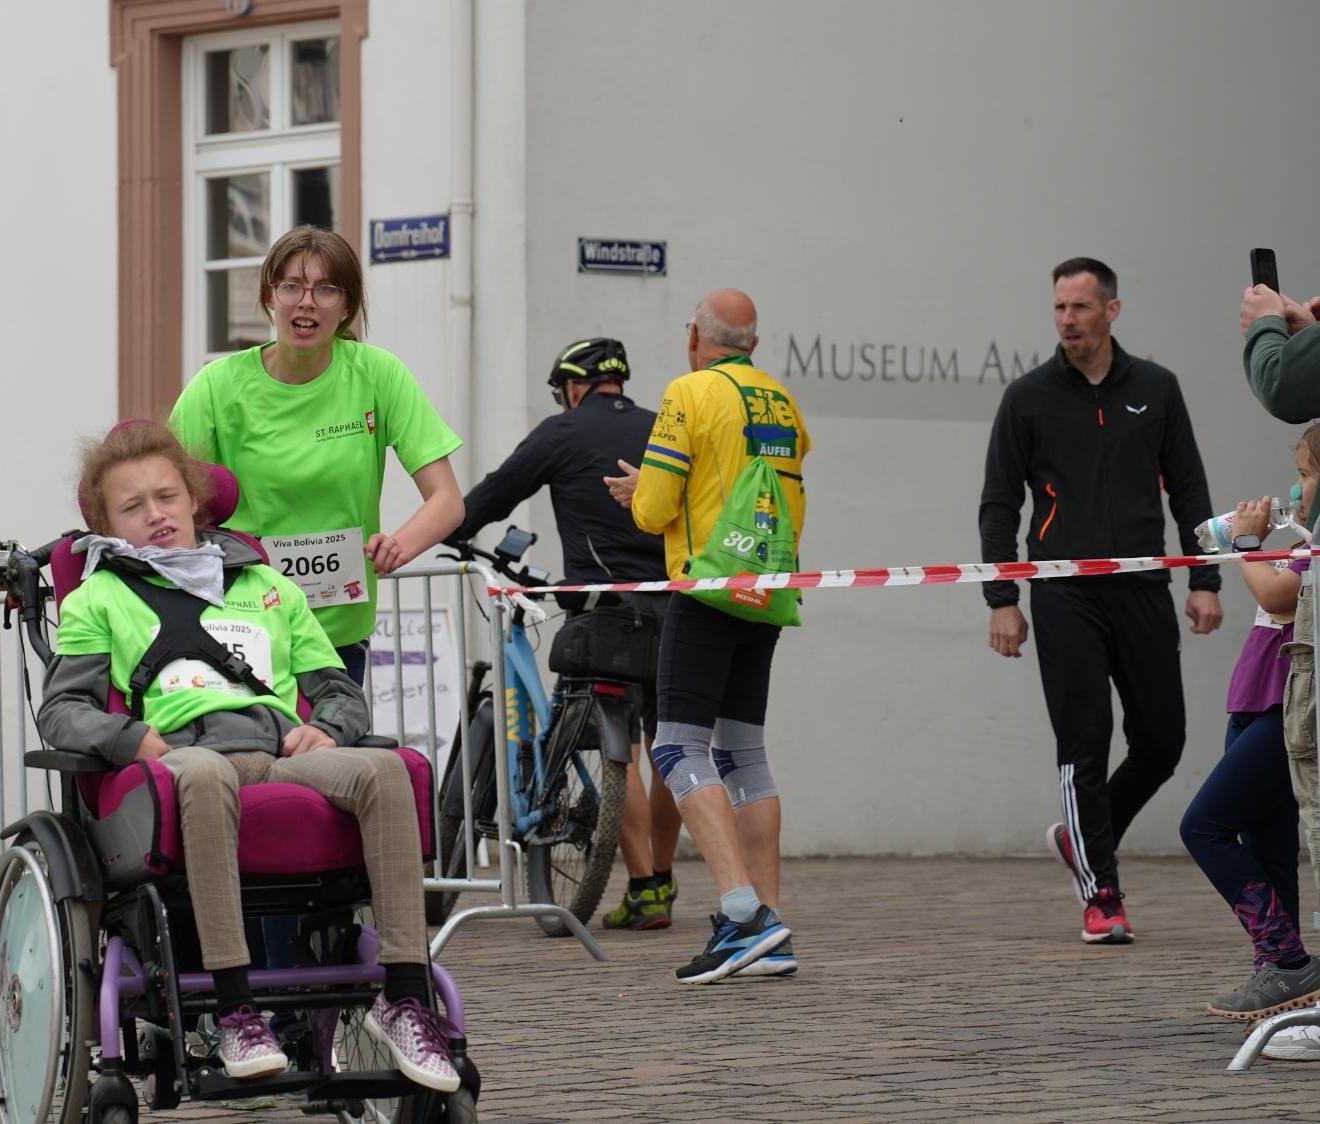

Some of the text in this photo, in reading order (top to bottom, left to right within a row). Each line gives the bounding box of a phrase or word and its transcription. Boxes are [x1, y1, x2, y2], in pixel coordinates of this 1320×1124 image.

[374, 221, 445, 248] Domfreihof
[583, 241, 661, 263] Windstraße
[328, 420, 365, 434] RAPHAEL
[760, 442, 791, 457] ÄUFER
[272, 533, 346, 548] Viva Bolivia 2025
[723, 530, 755, 552] 30
[280, 552, 340, 577] 2066
[204, 624, 252, 634] olivia 2025
